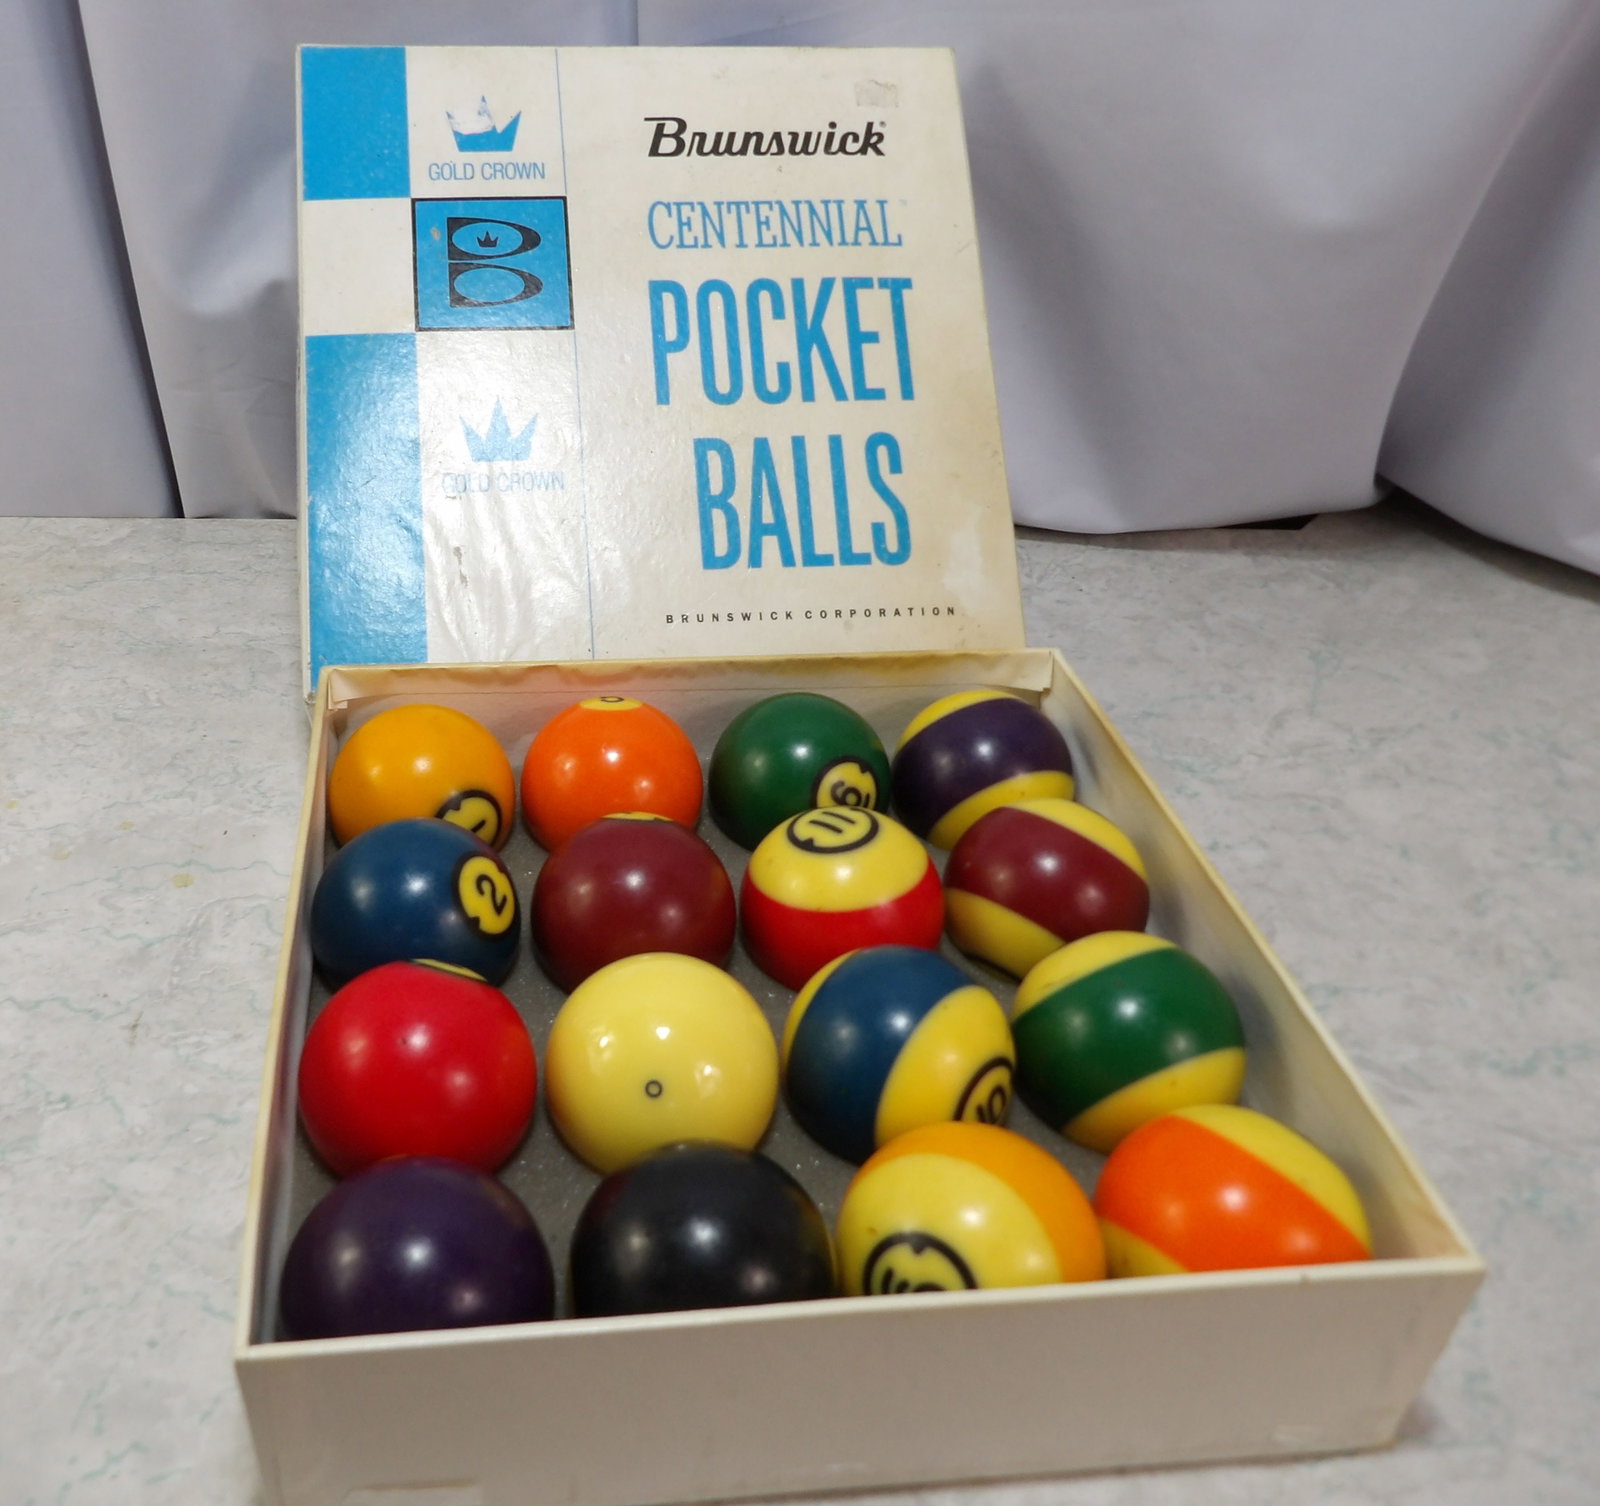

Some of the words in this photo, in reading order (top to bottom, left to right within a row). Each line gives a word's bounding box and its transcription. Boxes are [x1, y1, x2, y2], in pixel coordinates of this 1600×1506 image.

[428, 162, 475, 181] GOLD
[481, 162, 546, 181] CROWN
[647, 199, 903, 250] CENTENNIAL
[647, 276, 916, 406] POCKET
[441, 471, 492, 494] GOLD
[496, 470, 566, 493] CROWN
[692, 431, 912, 571] BALLS
[665, 610, 794, 624] BRUNSWICK
[804, 606, 956, 620] CORPORATION
[475, 874, 508, 917] 2
